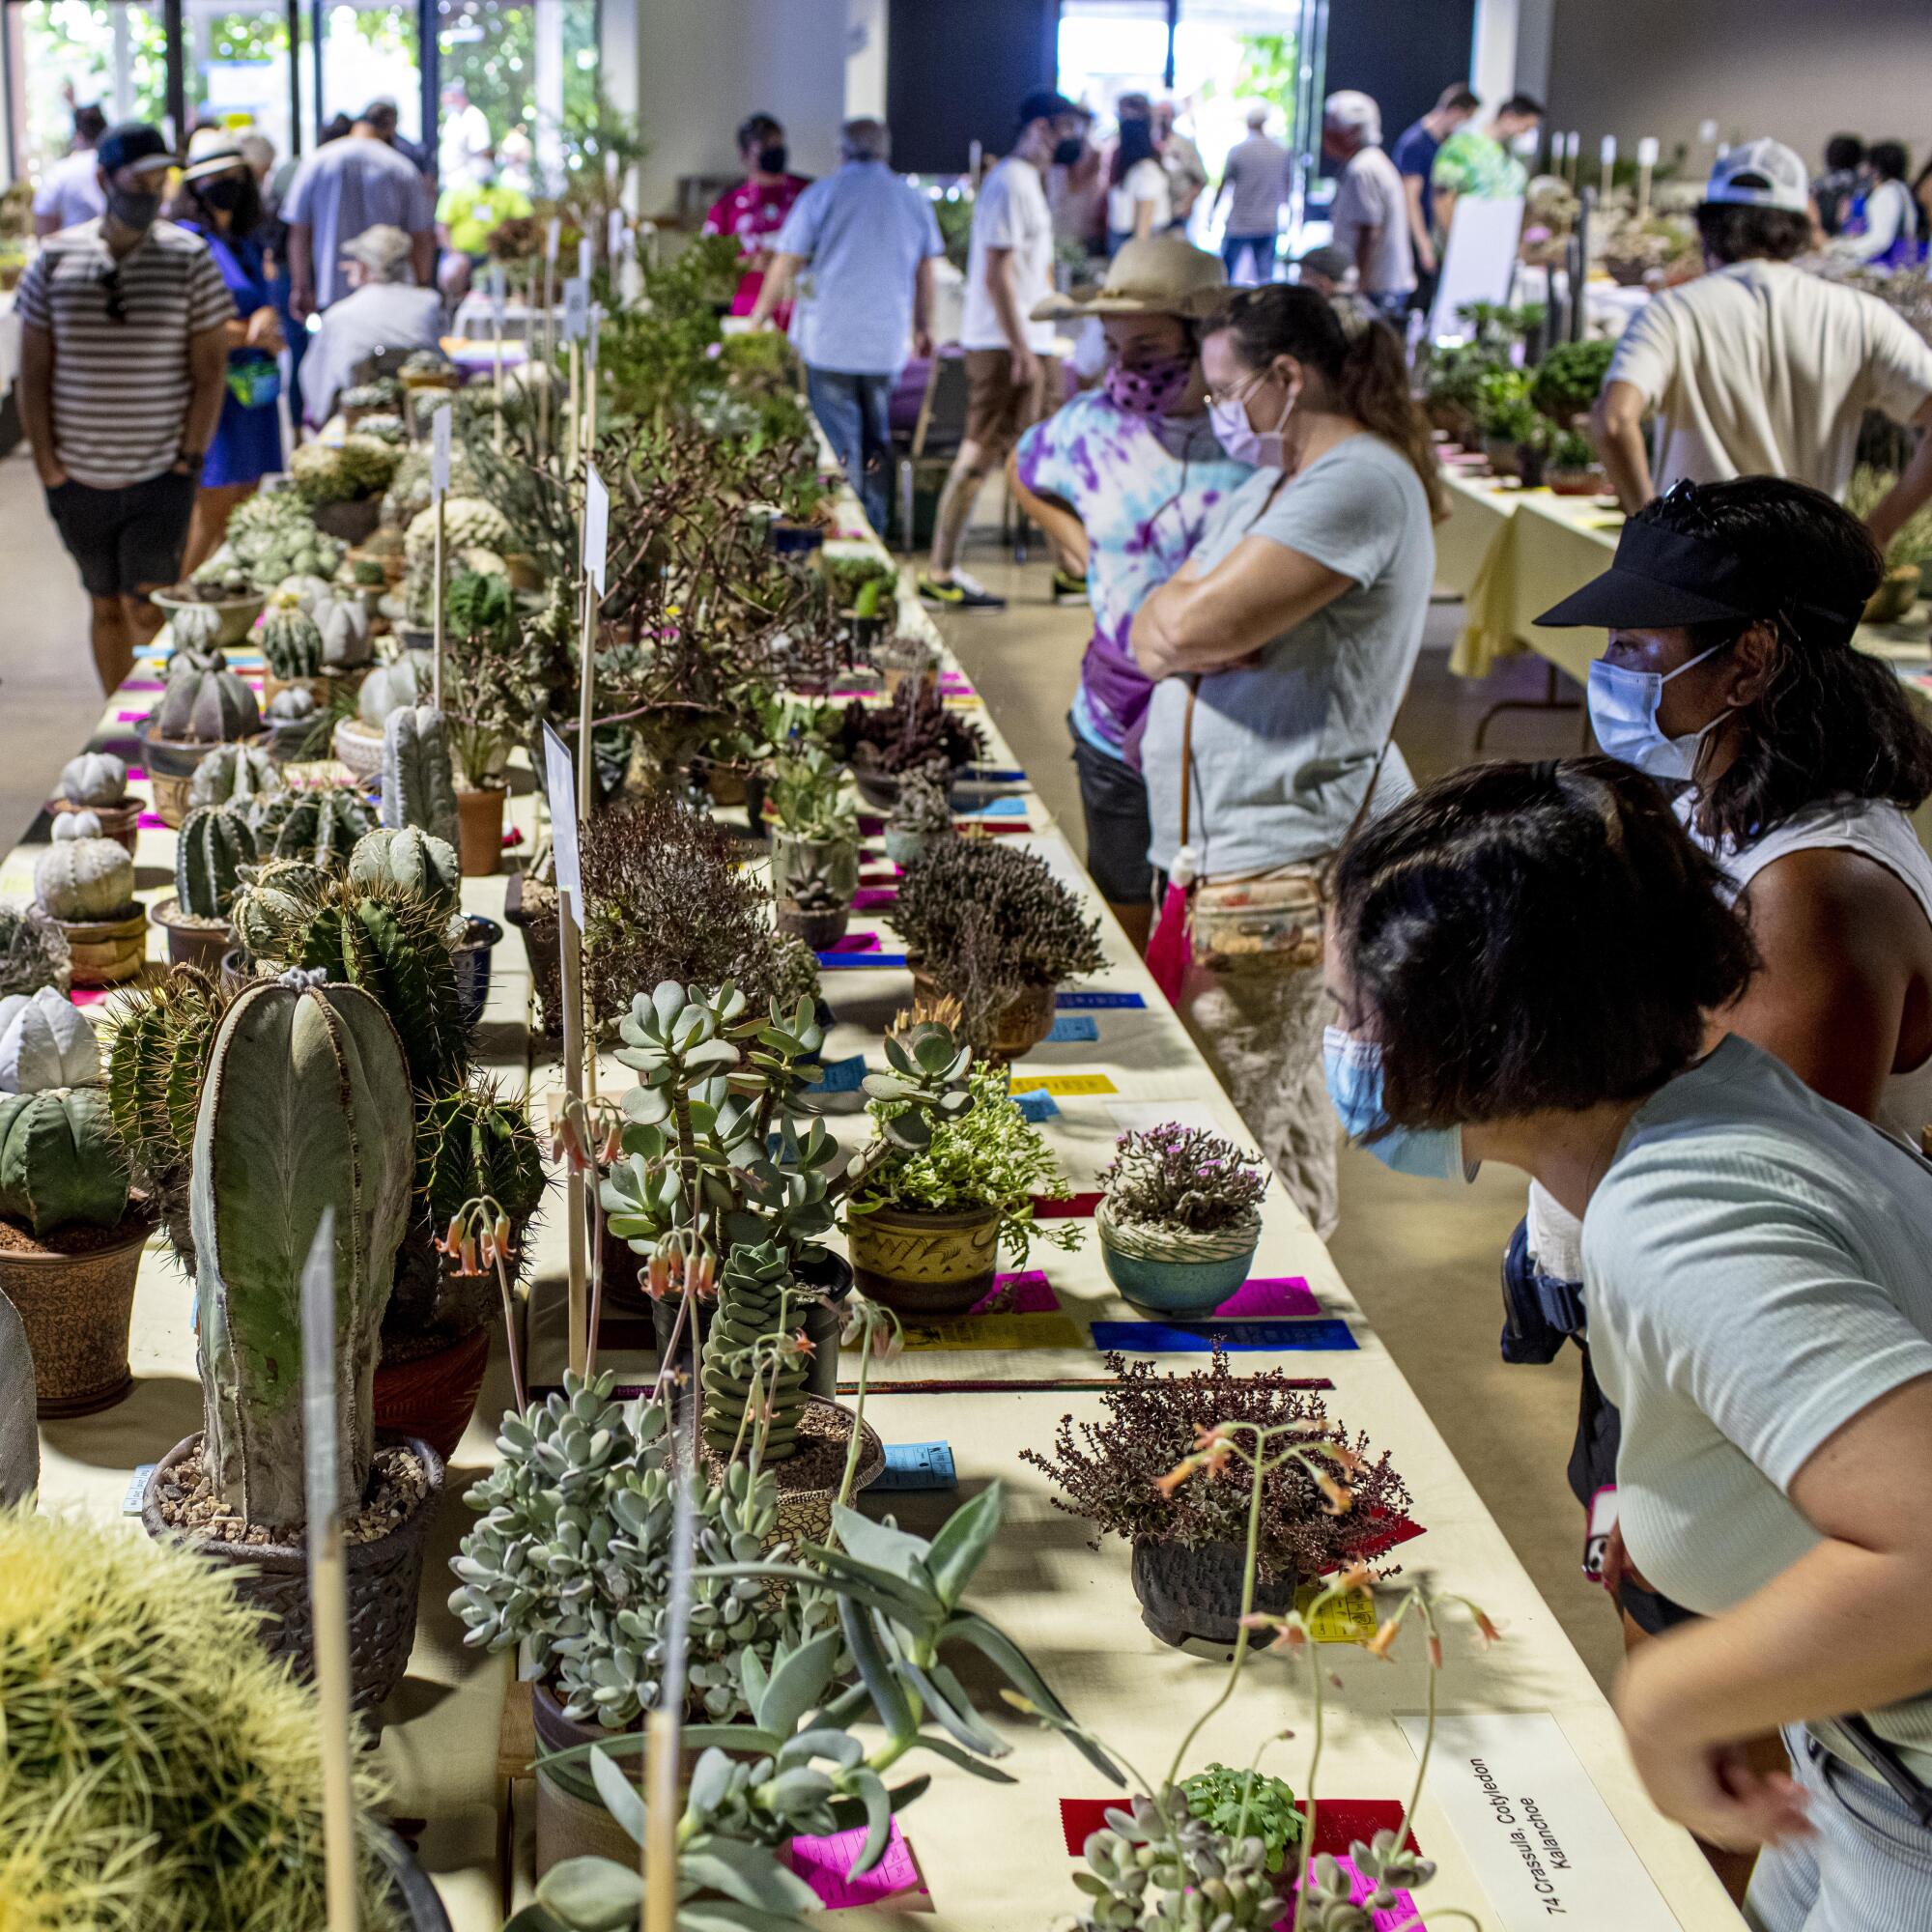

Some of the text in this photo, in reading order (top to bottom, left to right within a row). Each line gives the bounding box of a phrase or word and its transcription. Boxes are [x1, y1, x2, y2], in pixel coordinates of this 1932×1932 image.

[1470, 1758, 1567, 1916] 74 Crassula, Cotyledon
[1520, 1798, 1572, 1869] Kalanchoe
